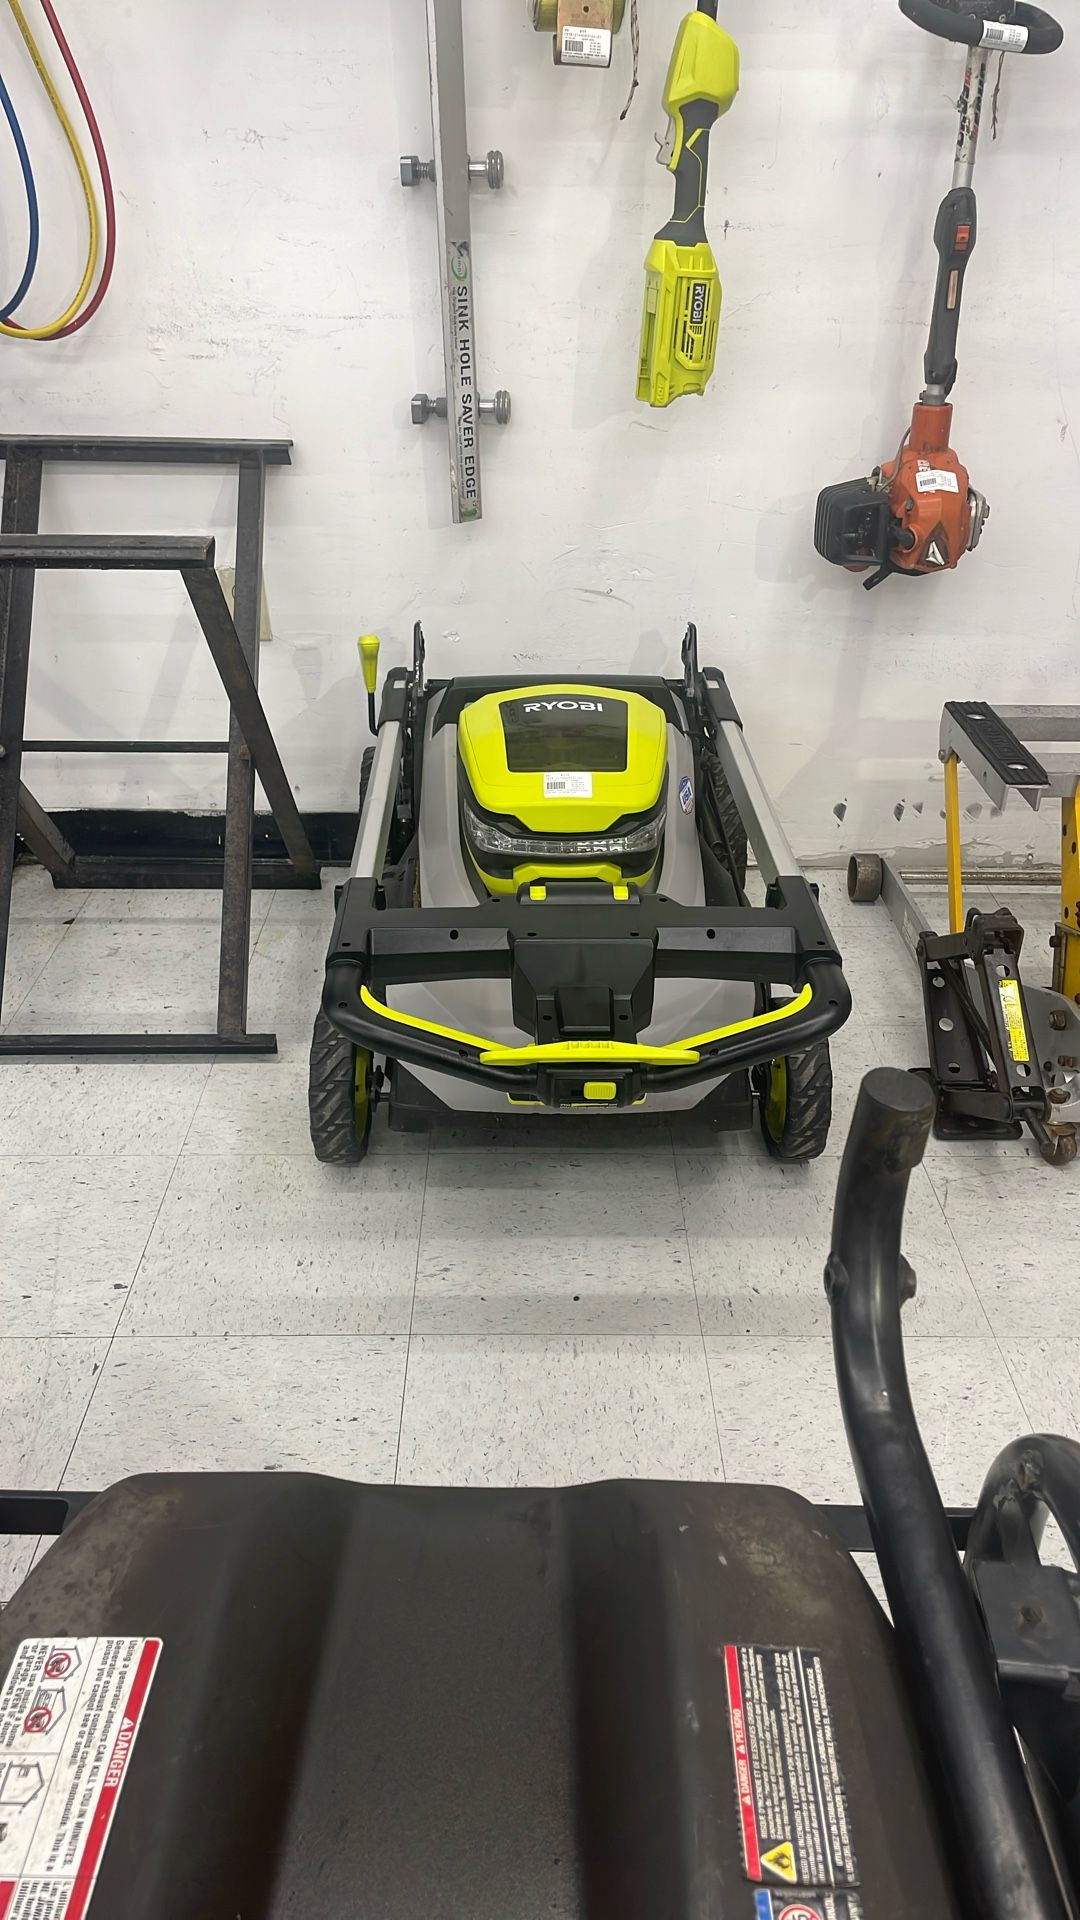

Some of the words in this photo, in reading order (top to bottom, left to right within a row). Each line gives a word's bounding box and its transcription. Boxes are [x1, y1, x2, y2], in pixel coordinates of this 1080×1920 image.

[457, 286, 469, 331] SINK
[692, 285, 705, 322] RYOBI
[460, 339, 471, 386] HOLE
[461, 393, 474, 448] SAVER
[464, 456, 477, 499] EDGE
[523, 701, 603, 713] RYOBI
[18, 1645, 30, 1659] and
[31, 1645, 49, 1671] NEVER
[99, 1639, 115, 1665] poison
[104, 1639, 125, 1678] Generator
[122, 1639, 138, 1661] Using
[5, 1661, 24, 1695] windows
[26, 1673, 39, 1687] use
[94, 1667, 106, 1681] you
[8, 1687, 23, 1709] EVEN
[16, 1689, 33, 1714] inside
[84, 1683, 101, 1711] cannot
[94, 1680, 112, 1711] exhaust
[108, 1670, 129, 1709] generator
[0, 1697, 11, 1711] are
[812, 1707, 821, 1724] POUR
[79, 1713, 92, 1728] see
[83, 1713, 102, 1748] contains
[98, 1710, 117, 1741] indoors
[732, 1707, 744, 1743] PELIGRO
[4, 1723, 21, 1747] home
[76, 1730, 87, 1738] or
[73, 1750, 91, 1780] carbon
[92, 1744, 107, 1761] CAN
[103, 1731, 132, 1787] DANGER
[86, 1764, 101, 1784] KILL
[737, 1758, 750, 1794] DANGER
[79, 1786, 94, 1806] YOU
[76, 1808, 88, 1818] IN
[51, 1831, 66, 1851] This
